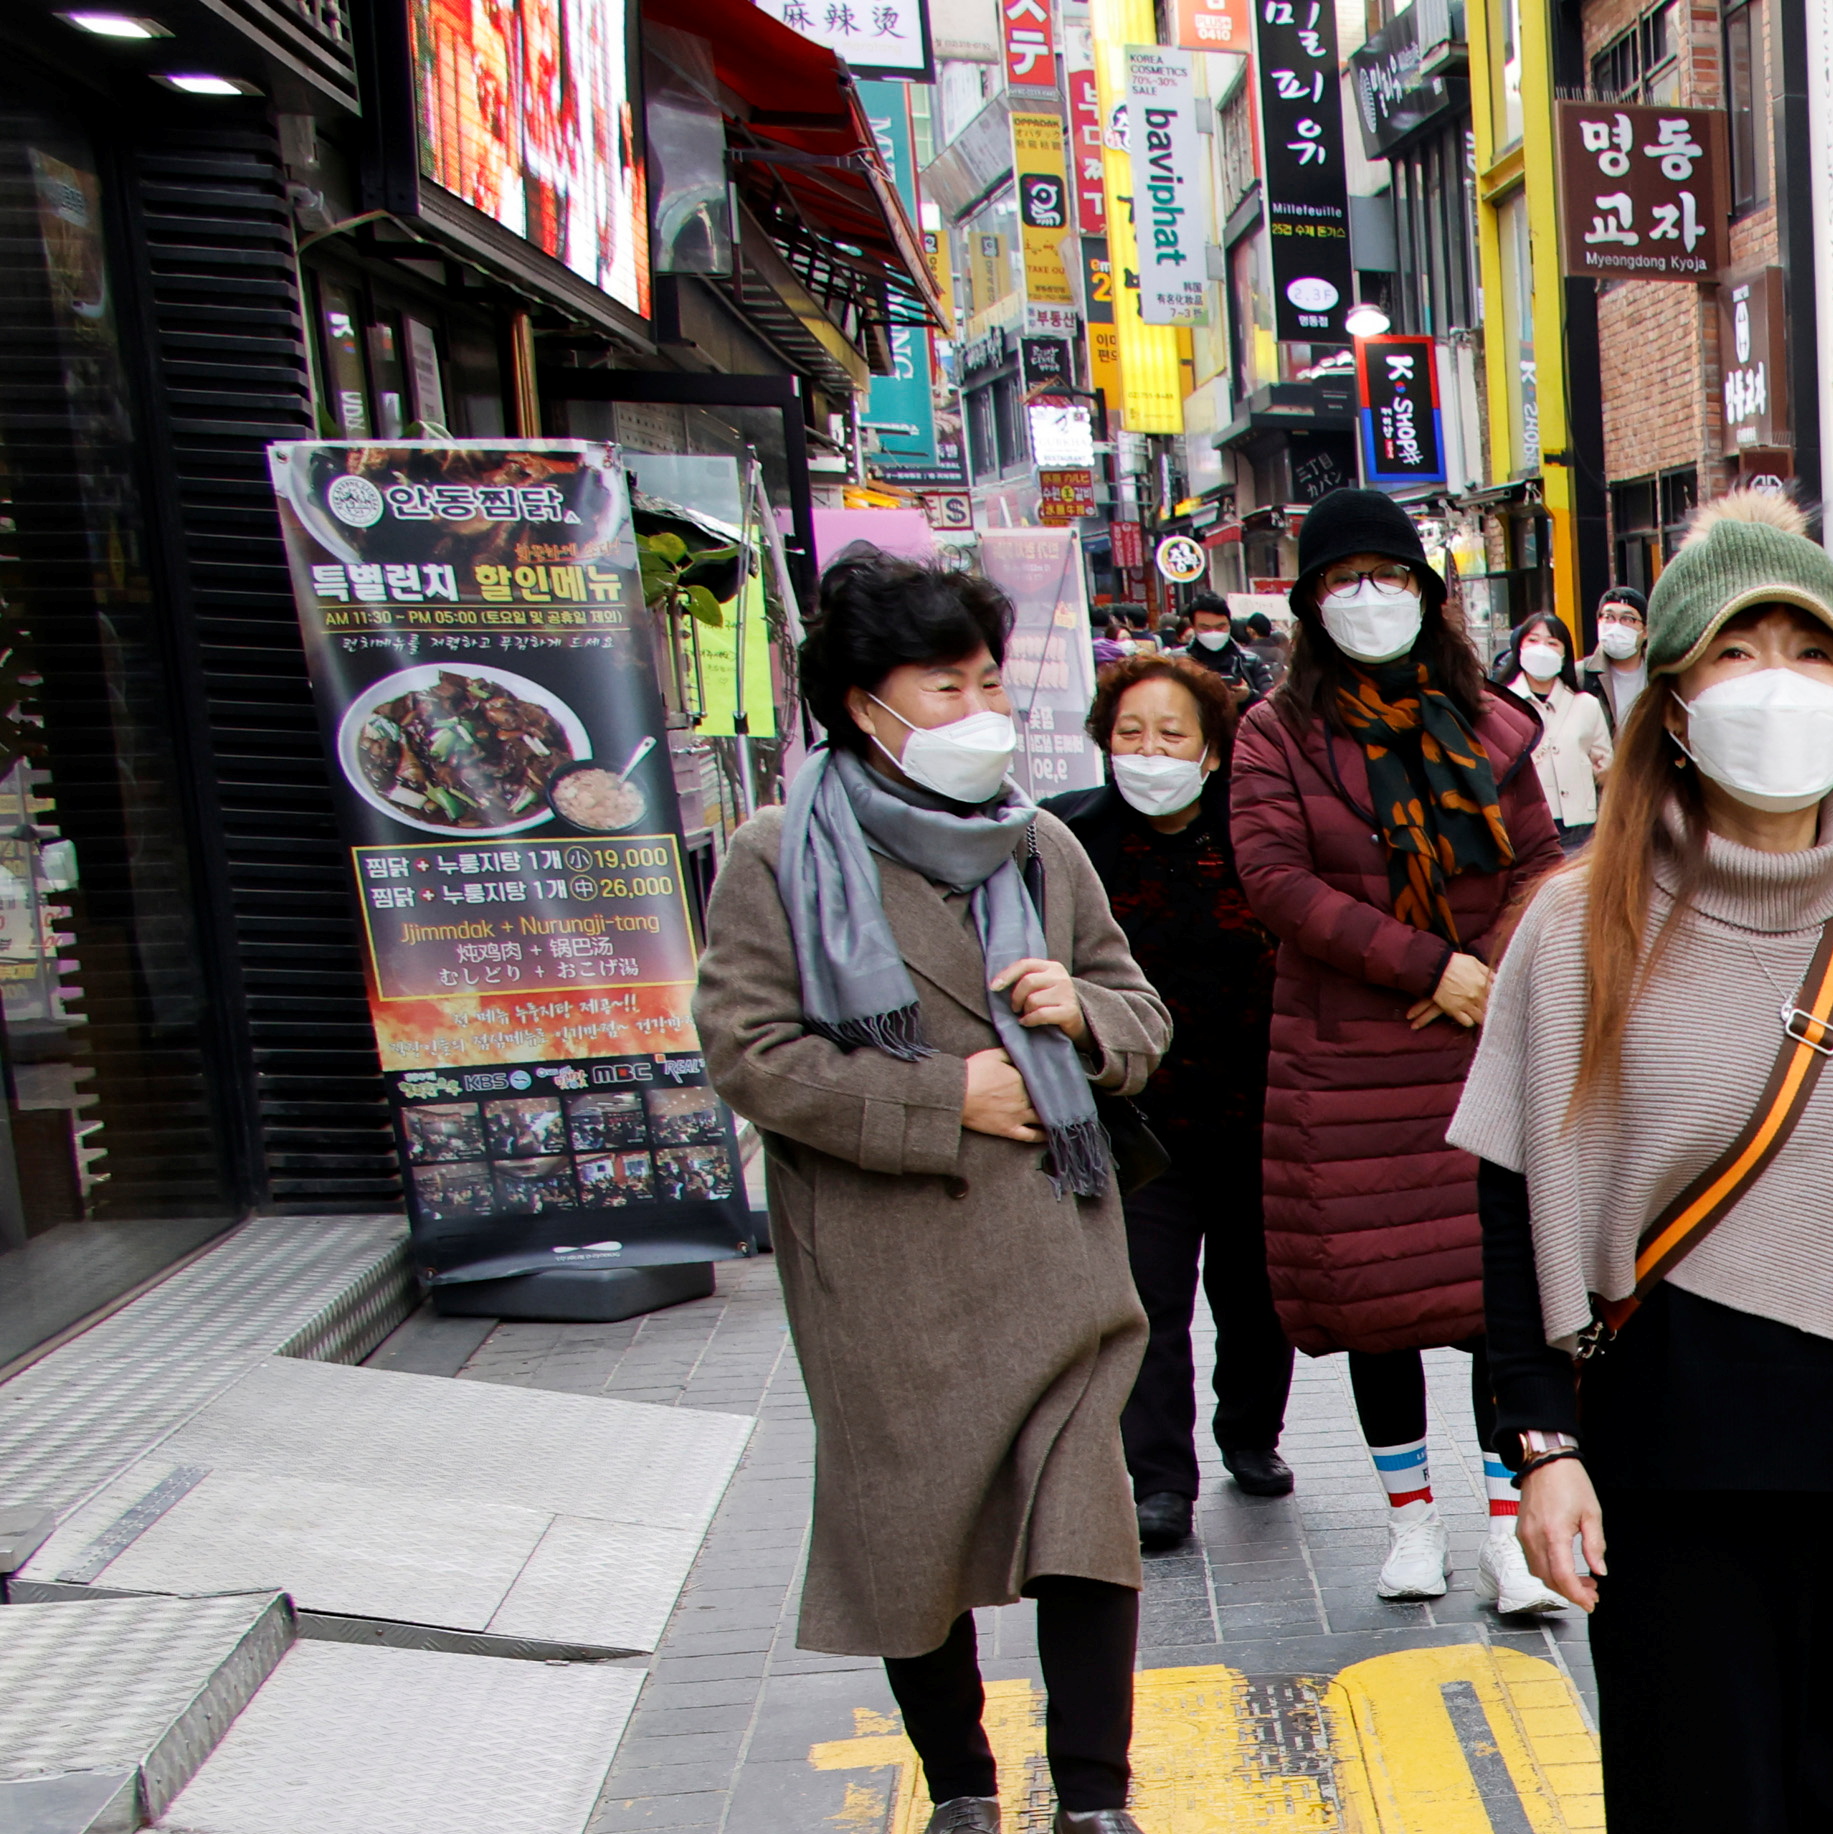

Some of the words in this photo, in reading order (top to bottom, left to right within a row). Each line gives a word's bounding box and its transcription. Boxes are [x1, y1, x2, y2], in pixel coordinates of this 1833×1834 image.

[1197, 28, 1231, 40] 0410
[1130, 54, 1164, 65] KOREA
[1130, 65, 1188, 78] COSMETICS
[1132, 86, 1158, 96] SALE
[1579, 113, 1703, 182] 명동
[1144, 107, 1187, 267] baviphat
[1272, 203, 1343, 218] Millefeuille
[1584, 191, 1706, 253] 교자
[1586, 251, 1666, 271] Myeongdong
[1671, 253, 1708, 272] Kyoja
[1036, 310, 1077, 328] 부동산
[385, 484, 566, 523] 안동찜닭
[312, 563, 461, 602] 특별런치
[475, 563, 622, 602] 할인메뉴
[325, 610, 350, 624] AM
[354, 610, 392, 624] 11:30
[409, 610, 432, 624] PM
[436, 610, 478, 624] 05:00
[365, 856, 410, 880] 찜닭
[437, 851, 522, 876] 누룽지탕
[528, 849, 564, 871] 1개
[594, 846, 669, 869] 19,000
[370, 886, 415, 909] 찜닭
[442, 880, 527, 905] 누룽지탕
[533, 878, 569, 901] 1개
[600, 876, 674, 899] 26,000
[401, 919, 495, 946] Jjimmdak
[521, 913, 660, 937] Nurungji-tang
[456, 941, 522, 964] 炖鸡肉
[550, 937, 614, 959] 锅巴汤
[439, 965, 522, 987] むしどり
[558, 958, 640, 979] おこげ湯
[464, 1072, 508, 1091] KBS
